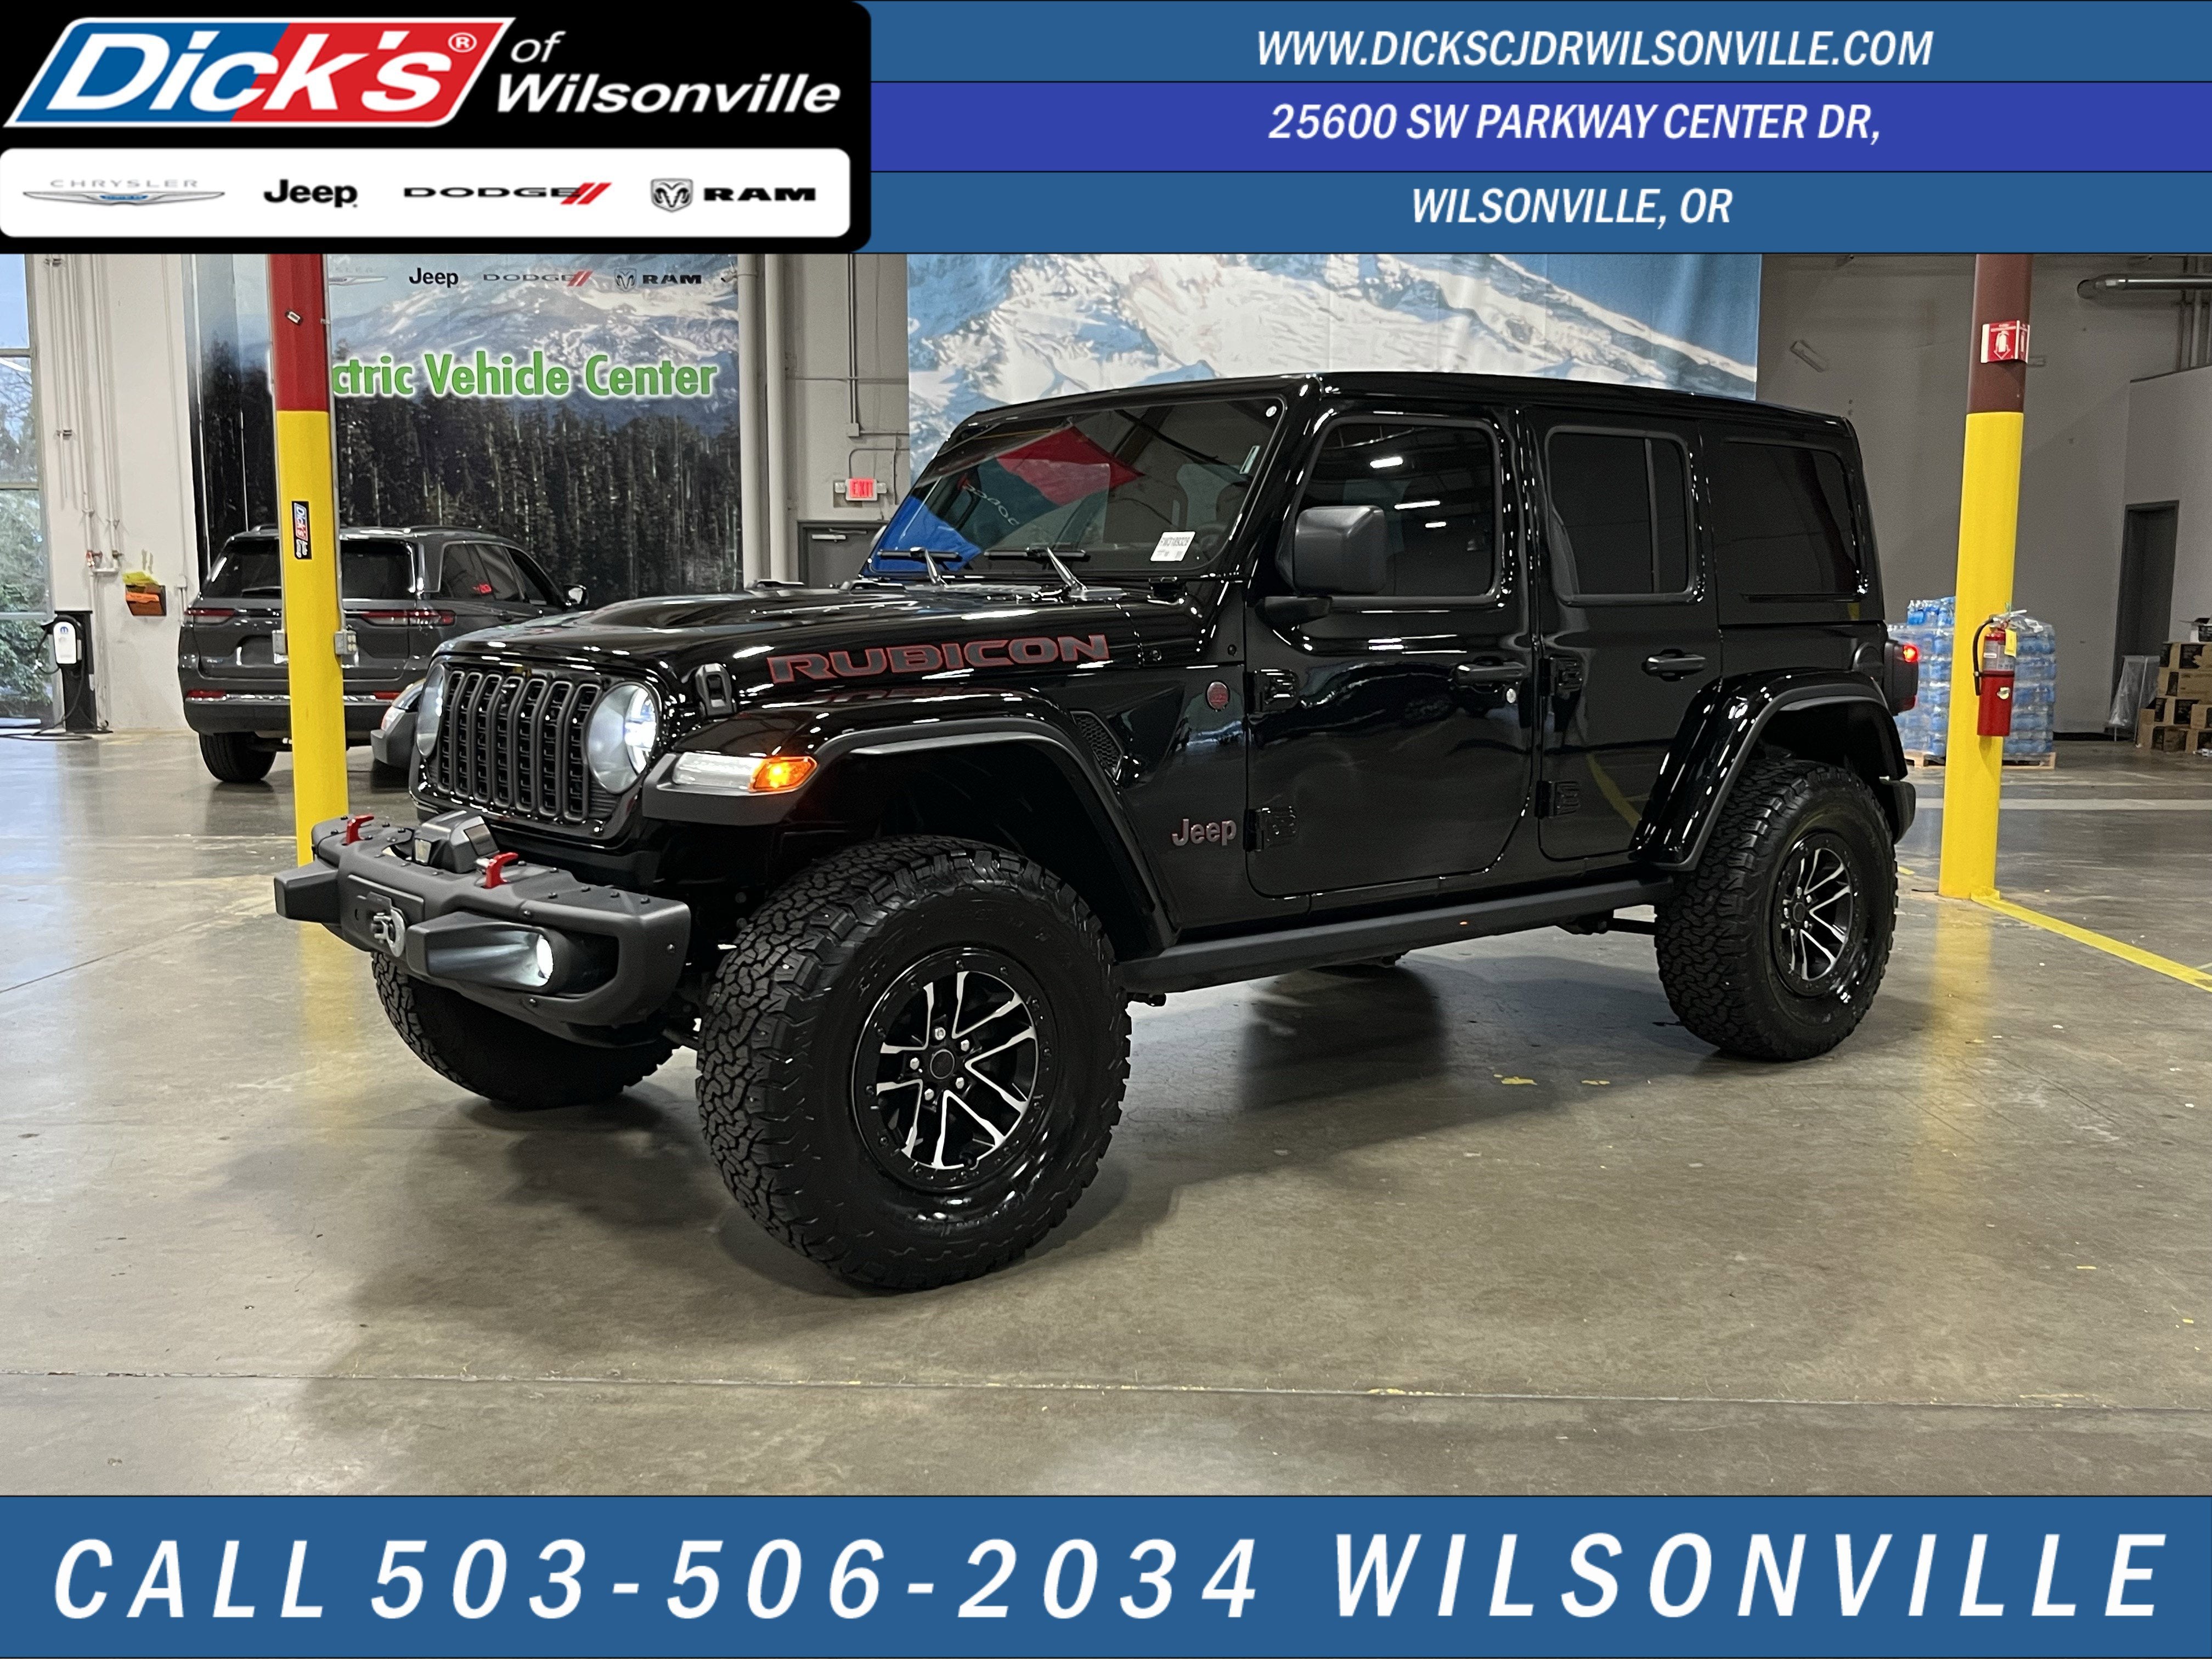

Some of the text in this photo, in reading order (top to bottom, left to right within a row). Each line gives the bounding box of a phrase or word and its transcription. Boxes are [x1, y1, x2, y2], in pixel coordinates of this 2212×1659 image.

[409, 267, 459, 289] Jeep
[483, 274, 574, 282] DODGE
[642, 274, 702, 285] RAM
[332, 351, 717, 396] ctric Vehicle Center
[850, 480, 873, 498] EXIT
[767, 634, 1109, 684] RUBICON
[1172, 819, 1237, 846] Jeep
